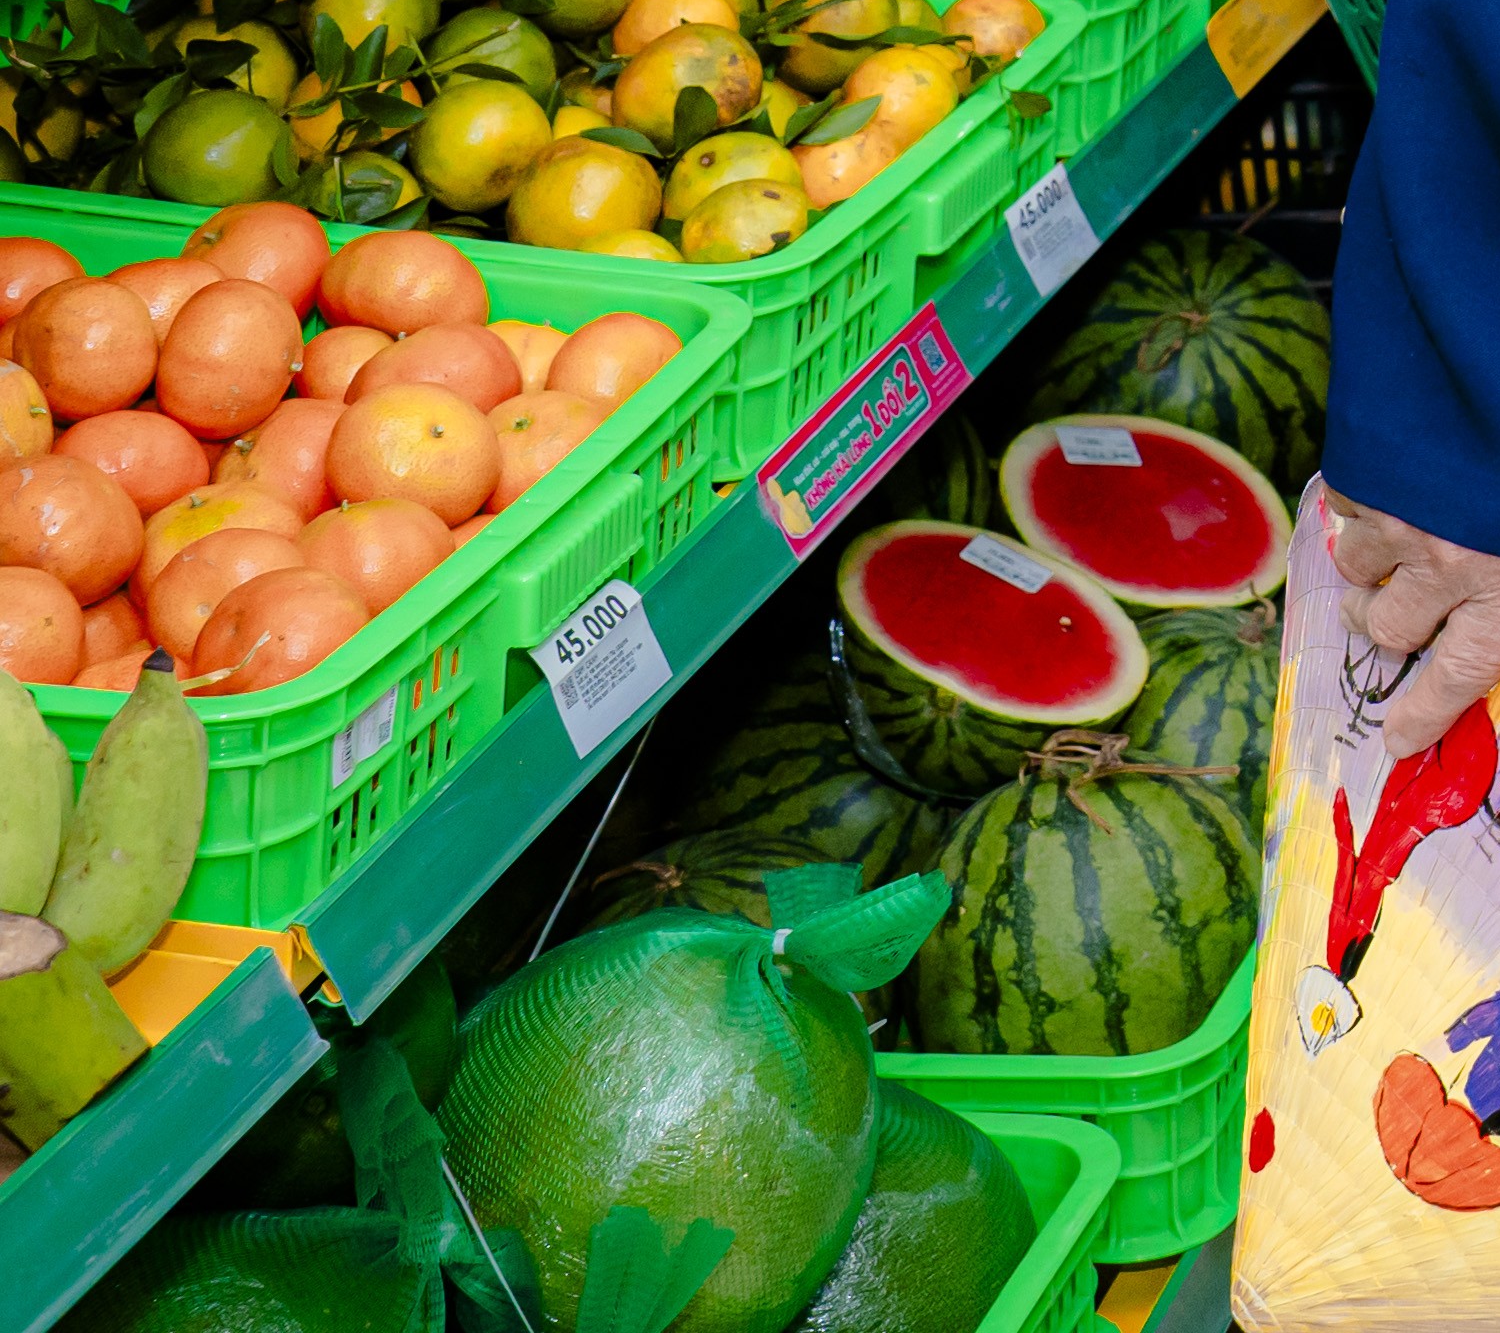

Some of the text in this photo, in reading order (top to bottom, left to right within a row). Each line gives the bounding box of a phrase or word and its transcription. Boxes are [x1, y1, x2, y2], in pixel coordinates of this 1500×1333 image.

[861, 359, 922, 441] 1 ĐỔI 2
[554, 593, 630, 667] 45.000
